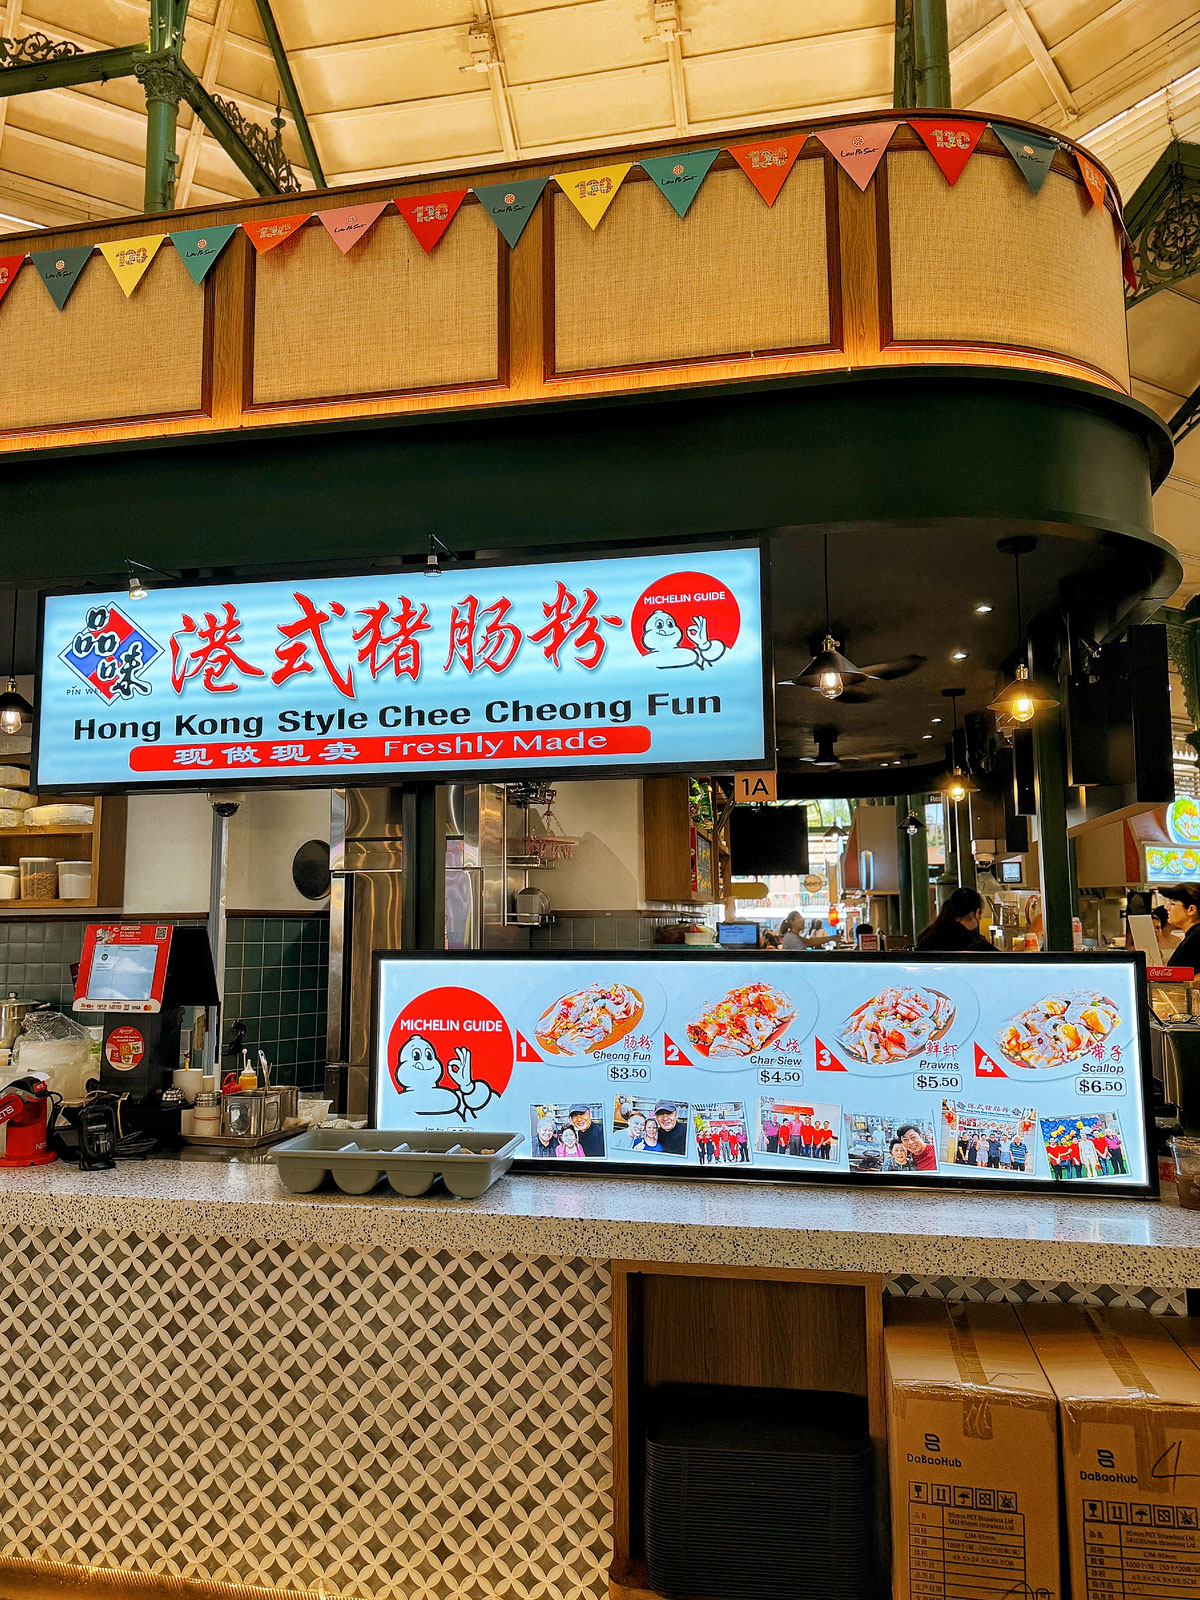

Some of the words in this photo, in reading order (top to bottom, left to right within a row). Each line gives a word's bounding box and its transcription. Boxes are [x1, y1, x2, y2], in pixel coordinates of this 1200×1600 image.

[643, 593, 691, 605] MICHELIN
[692, 591, 726, 602] GUIDE
[169, 580, 624, 698] 港式猪肠粉
[74, 719, 161, 742] Hong
[175, 713, 263, 738] Kong
[277, 708, 368, 735] Style
[378, 705, 471, 728] Chee
[485, 699, 631, 723] Cheong
[648, 692, 721, 716] Fun
[384, 735, 504, 757] Freshly
[513, 731, 608, 751] Made
[173, 742, 361, 765] 现做现卖
[741, 777, 770, 796] 1A
[400, 1019, 460, 1031] MICHELIN
[463, 1019, 503, 1032] GUIDE
[520, 1041, 527, 1057] 1
[624, 1034, 654, 1050] 肠粉
[772, 1037, 801, 1054] 叉烧
[925, 1040, 958, 1058] 鲜虾
[593, 1050, 630, 1062] Cheong
[632, 1051, 651, 1061] Fun
[666, 1044, 680, 1061] 2
[750, 1055, 774, 1065] Char
[777, 1056, 803, 1066] Siew
[819, 1049, 832, 1067] 3
[1090, 1043, 1122, 1062] 带子
[919, 1059, 960, 1070] Prawns
[977, 1055, 994, 1073] 4
[1081, 1063, 1124, 1075] Scallop
[610, 1066, 647, 1080] $3.50
[760, 1069, 801, 1084] $4.50
[917, 1075, 959, 1090] $5.50
[1079, 1079, 1123, 1094] $6.50
[906, 1453, 962, 1468] DaBaoHub
[1079, 1470, 1138, 1484] DaBaoHub
